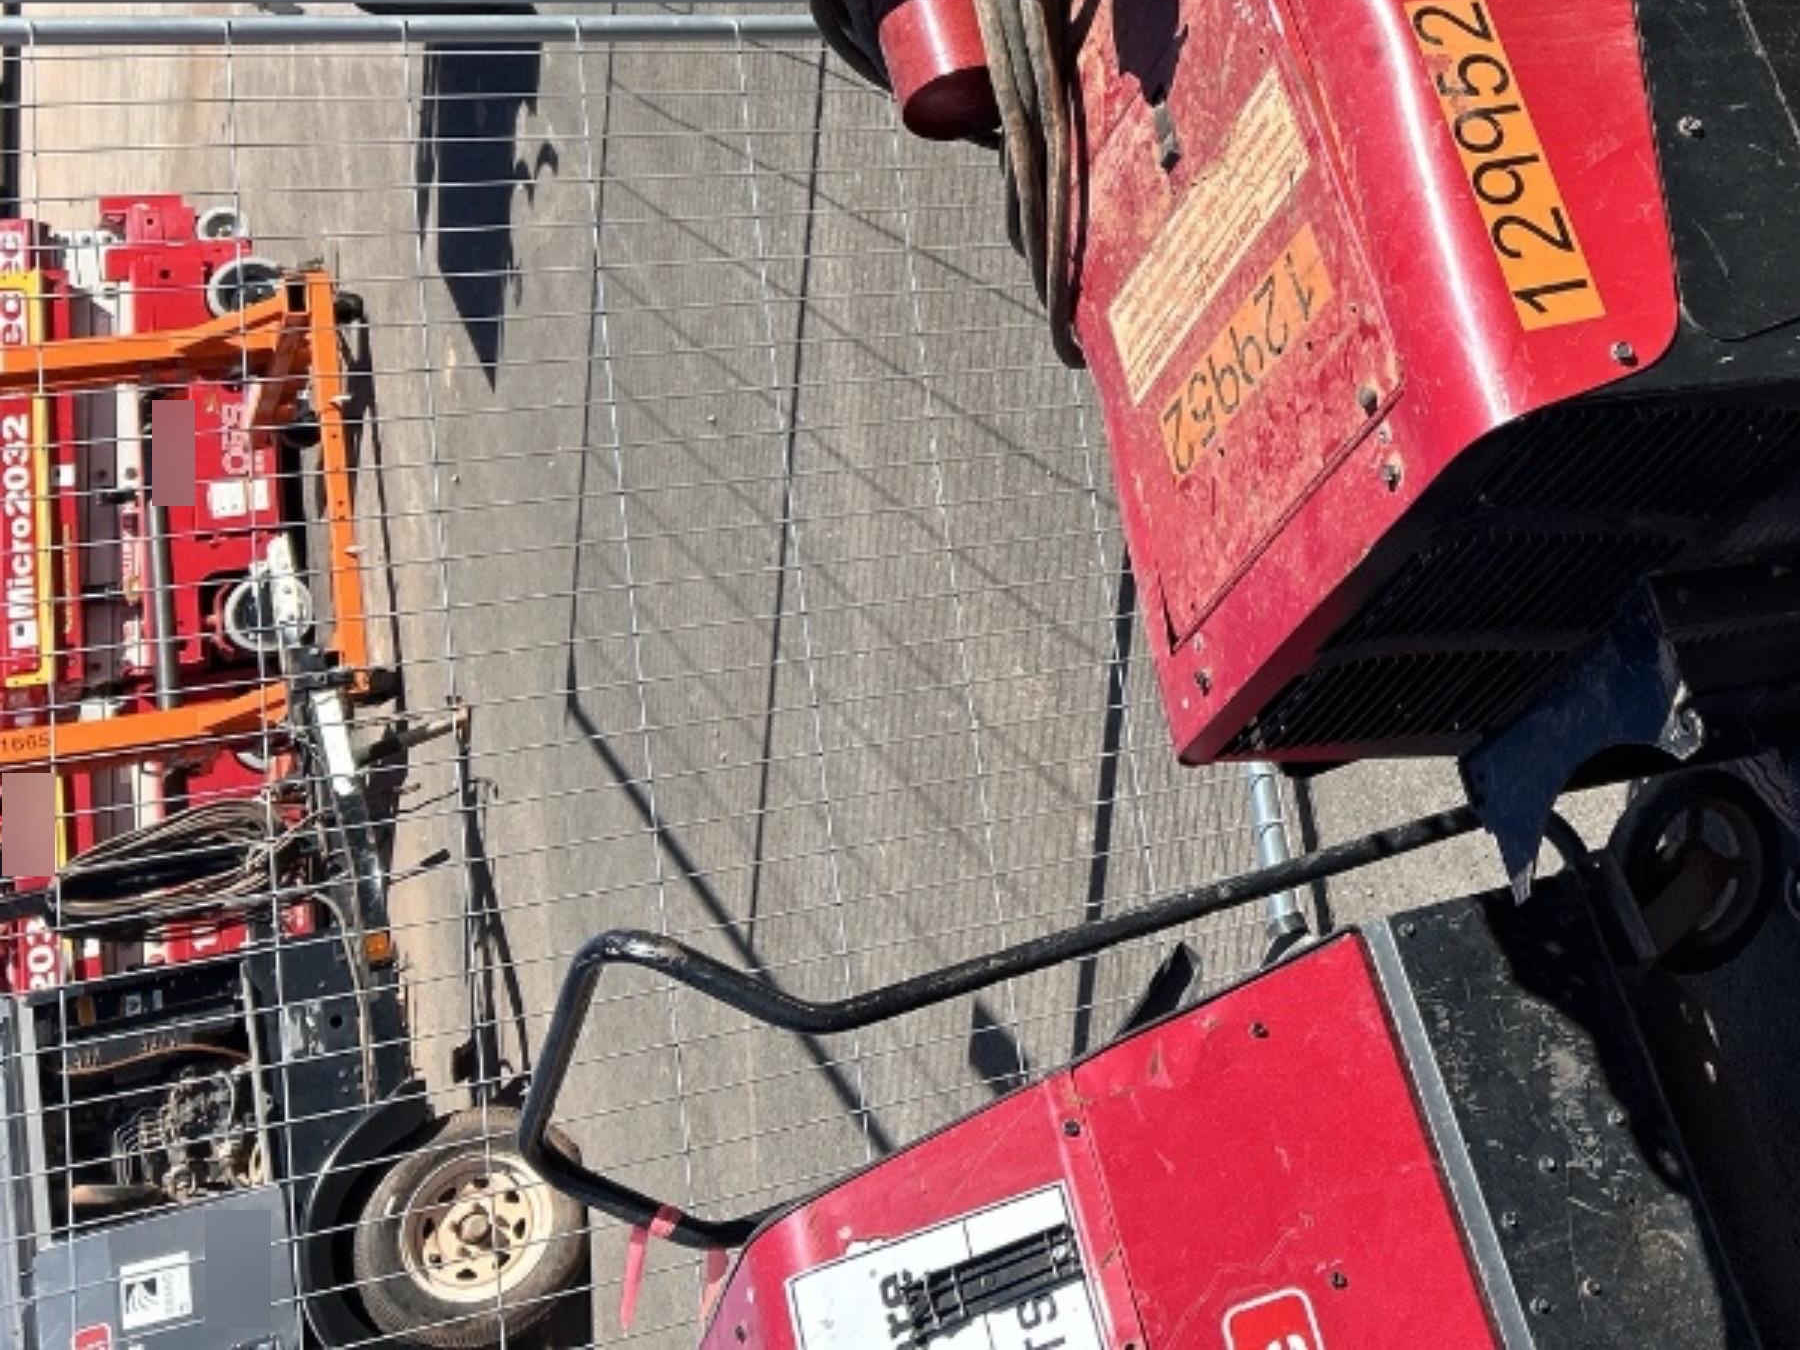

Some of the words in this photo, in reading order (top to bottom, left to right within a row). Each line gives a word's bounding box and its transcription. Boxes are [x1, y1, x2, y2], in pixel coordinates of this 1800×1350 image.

[1412, 0, 1591, 318] 129952
[1163, 252, 1316, 476] 129952
[5, 414, 35, 620] Micro2032
